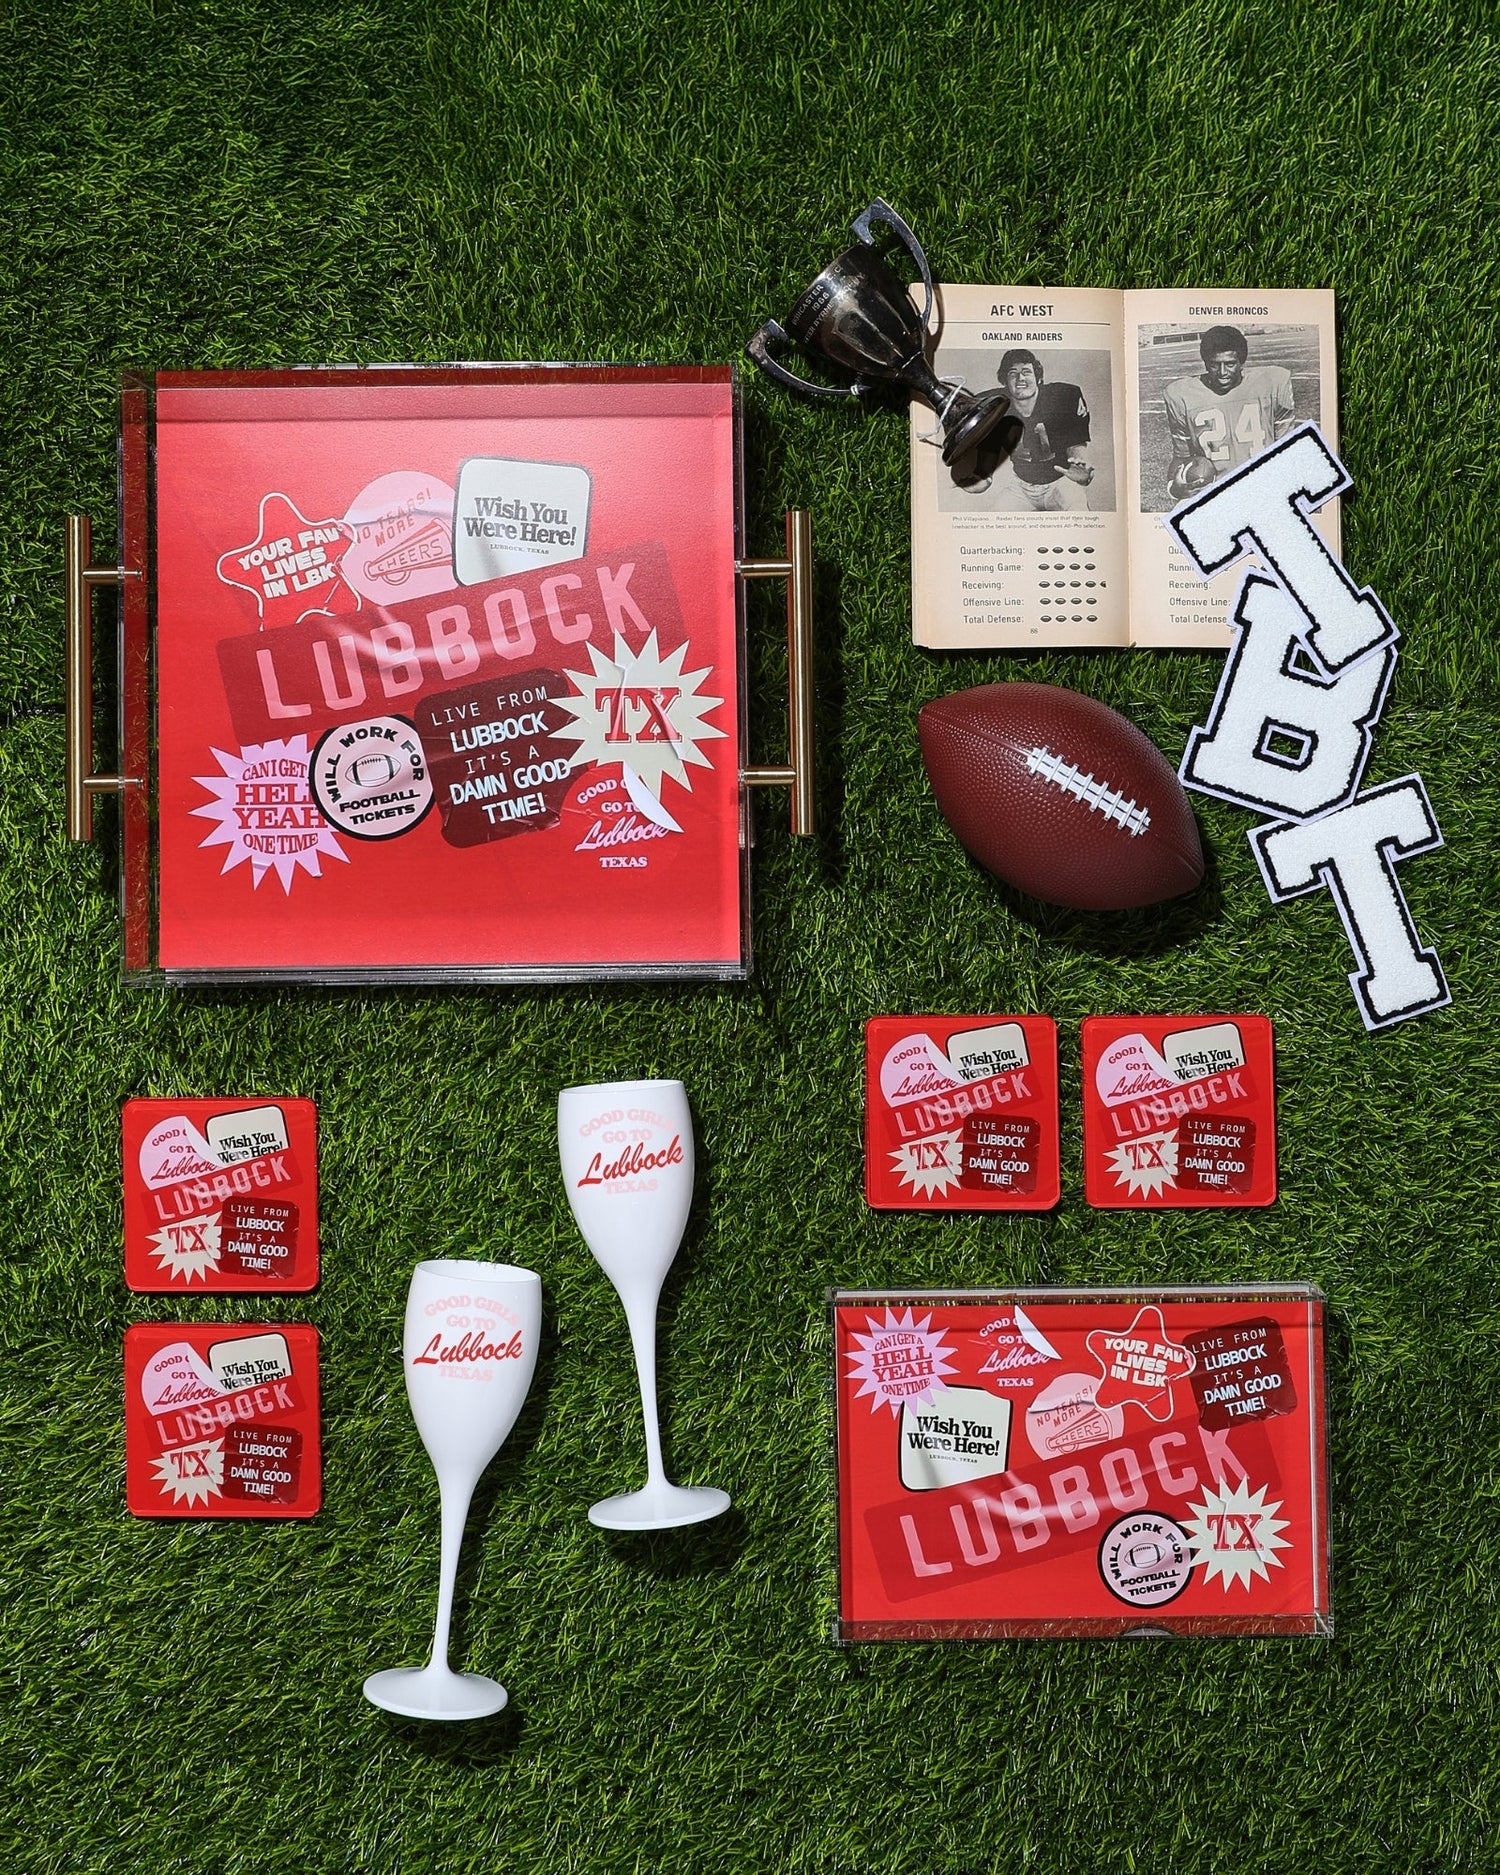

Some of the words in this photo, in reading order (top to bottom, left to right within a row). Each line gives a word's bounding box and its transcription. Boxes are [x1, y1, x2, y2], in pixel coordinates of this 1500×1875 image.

[990, 304, 1014, 316] AFC
[1019, 304, 1054, 316] WEST
[1188, 306, 1224, 316] DENVER
[1226, 306, 1269, 316] BRONCOS
[982, 332, 1022, 341] OAKLAND
[1026, 333, 1063, 342] RAIDERS
[1194, 403, 1266, 461] 24
[376, 488, 432, 531] TEARS!
[474, 496, 527, 522] Wish
[529, 502, 568, 525] You
[375, 516, 415, 547] MORE
[463, 517, 517, 539] Were
[518, 523, 577, 546] Here!
[238, 537, 292, 571] YOUR
[298, 527, 340, 549] FAV
[377, 538, 444, 572] CHEERS
[960, 546, 1025, 556] Quarterbacking:
[261, 546, 326, 581] LIVES
[961, 564, 994, 573] Running
[998, 563, 1024, 572] Game:
[262, 579, 288, 598] IN
[291, 563, 336, 592] LBK
[962, 581, 1004, 590] Receiving:
[1169, 580, 1211, 590] Receiving:
[962, 598, 1001, 606] Offensive
[1004, 598, 1024, 606] Line:
[1170, 598, 1208, 606] Offensive
[1211, 598, 1230, 606] Line:
[964, 615, 984, 624] Total
[987, 614, 1024, 624] Defense:
[1170, 615, 1190, 623] Total
[256, 562, 652, 721] LUBBOCK
[430, 702, 480, 727] LIVE
[496, 686, 548, 711] FROM
[595, 687, 682, 744] TX
[450, 711, 548, 752] LUBBOCK
[324, 754, 342, 803] WILL
[339, 726, 398, 748] WORK
[400, 740, 424, 781] FOR
[464, 751, 512, 774] IT'S
[528, 745, 540, 758] A
[450, 774, 508, 806] DAMN
[513, 758, 572, 788] GOOD
[577, 779, 618, 804] GOOD
[235, 784, 310, 806] HEL
[339, 790, 420, 812] FOOTBALL
[232, 807, 328, 830] YEAH
[350, 804, 416, 824] TICKETS
[482, 792, 547, 824] TIME!
[601, 802, 622, 813] GO
[242, 833, 276, 854] ONE
[277, 832, 318, 854] TIME
[574, 815, 669, 852] Lubbock
[599, 856, 648, 868] TEXAS
[960, 1053, 992, 1068] Wish
[994, 1050, 1016, 1062] You
[1176, 1053, 1208, 1068] Wish
[1209, 1050, 1232, 1062] You
[895, 1073, 1032, 1136] LUBBOCK
[1111, 1073, 1248, 1136] LUBBOCK
[579, 1110, 625, 1137] GOOD
[627, 1108, 674, 1132] GIRLS
[219, 1136, 252, 1150] Wish
[253, 1132, 276, 1145] You
[602, 1130, 627, 1144] GO
[629, 1128, 652, 1141] TO
[978, 1133, 1025, 1148] LUBBOCK
[1193, 1133, 1241, 1148] LUBBOCK
[577, 1134, 684, 1188] Lubbock
[909, 1140, 953, 1170] TX
[1125, 1140, 1168, 1170] TX
[154, 1156, 291, 1220] LUBBOCK
[604, 1179, 658, 1194] TEXAS
[982, 1172, 1012, 1185] TIME!
[1198, 1172, 1228, 1185] TIME!
[236, 1217, 285, 1232] LUBBOCK
[168, 1224, 212, 1254] TX
[241, 1257, 271, 1270] TIME!
[424, 1296, 471, 1316] GOOD
[474, 1297, 520, 1326] GIRLS
[446, 1314, 471, 1328] GO
[474, 1318, 496, 1331] TO
[979, 1318, 1010, 1338] GOOD
[412, 1330, 522, 1364] Lubbock
[998, 1336, 1016, 1345] GO
[1104, 1338, 1148, 1353] YOUR
[1154, 1346, 1184, 1363] FAV
[1192, 1338, 1224, 1354] LIVE
[1234, 1328, 1266, 1344] FROM
[872, 1347, 932, 1367] HELL
[978, 1346, 1050, 1374] Lubbock
[1116, 1353, 1167, 1373] LIVES
[1204, 1344, 1267, 1371] LUBBOCK
[222, 1363, 254, 1377] Wish
[256, 1360, 279, 1372] You
[439, 1365, 493, 1382] TEXAS
[872, 1361, 935, 1382] YEAH
[1110, 1366, 1130, 1380] IN
[1132, 1372, 1166, 1388] LBK
[1214, 1370, 1244, 1386] IT'S
[1254, 1365, 1262, 1375] A
[882, 1383, 904, 1396] ONE
[904, 1378, 930, 1395] TIME
[997, 1378, 1034, 1387] TEXAS
[1204, 1384, 1240, 1405] DAMN
[1244, 1374, 1282, 1394] GOOD
[157, 1383, 294, 1446] LUBBOCK
[1036, 1412, 1050, 1427] NO
[1054, 1386, 1094, 1415] TEARS!
[1054, 1405, 1082, 1428] MORE
[1225, 1397, 1265, 1417] TIME!
[917, 1415, 958, 1436] Wish
[962, 1420, 992, 1439] You
[1054, 1420, 1101, 1446] CHEERS
[239, 1443, 288, 1458] LUBBOCK
[908, 1432, 951, 1450] Were
[954, 1438, 1000, 1456] Here!
[170, 1450, 214, 1479] TX
[244, 1482, 274, 1495] TIME!
[900, 1426, 1249, 1578] LUBBOCK
[1206, 1514, 1264, 1551] TX
[1110, 1542, 1122, 1580] WILL
[1120, 1522, 1164, 1540] WORK
[1166, 1533, 1182, 1564] FOR
[1120, 1570, 1180, 1588] FOOTBALL
[1128, 1581, 1176, 1597] TICKETS
